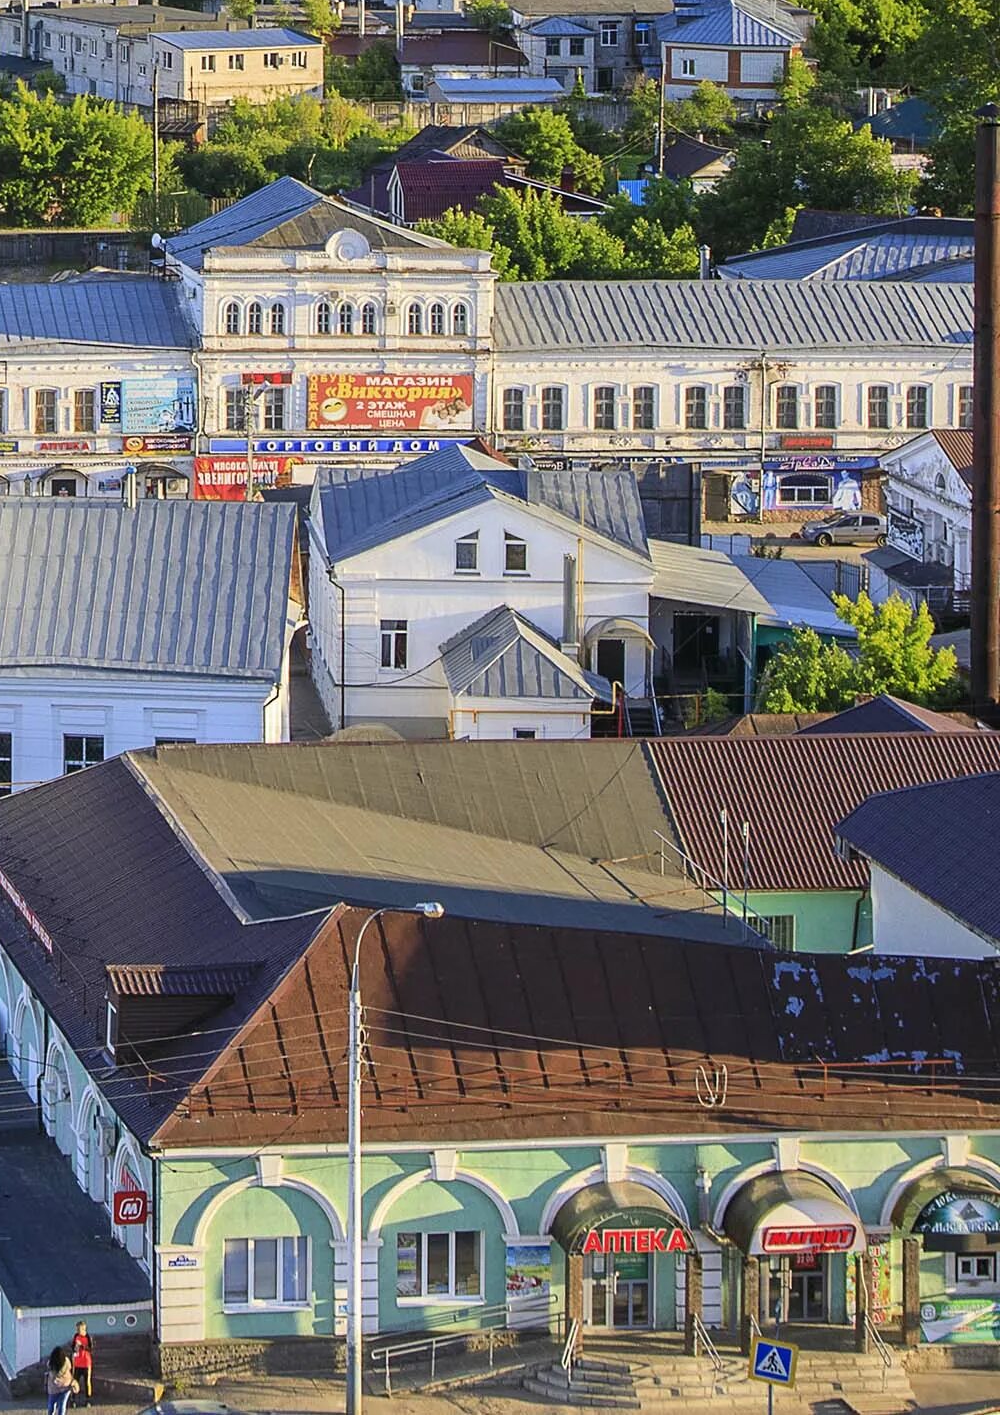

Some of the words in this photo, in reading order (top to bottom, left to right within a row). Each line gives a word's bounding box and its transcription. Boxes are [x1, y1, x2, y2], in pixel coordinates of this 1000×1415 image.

[366, 376, 453, 386] МАГАЗИН
[325, 383, 462, 401] «Виктория»
[356, 401, 364, 409] 2
[368, 401, 406, 409] ЭТАЖ
[367, 410, 416, 418] СМЕШНАЯ
[379, 420, 405, 428] ЦЕНА
[39, 442, 90, 451] АПТЕКА
[252, 439, 378, 452] ТОРГОВЫЙ
[392, 440, 440, 452] ДОМ
[582, 1227, 688, 1254] АПТЕКА
[767, 1229, 851, 1246] МАГНИТ
